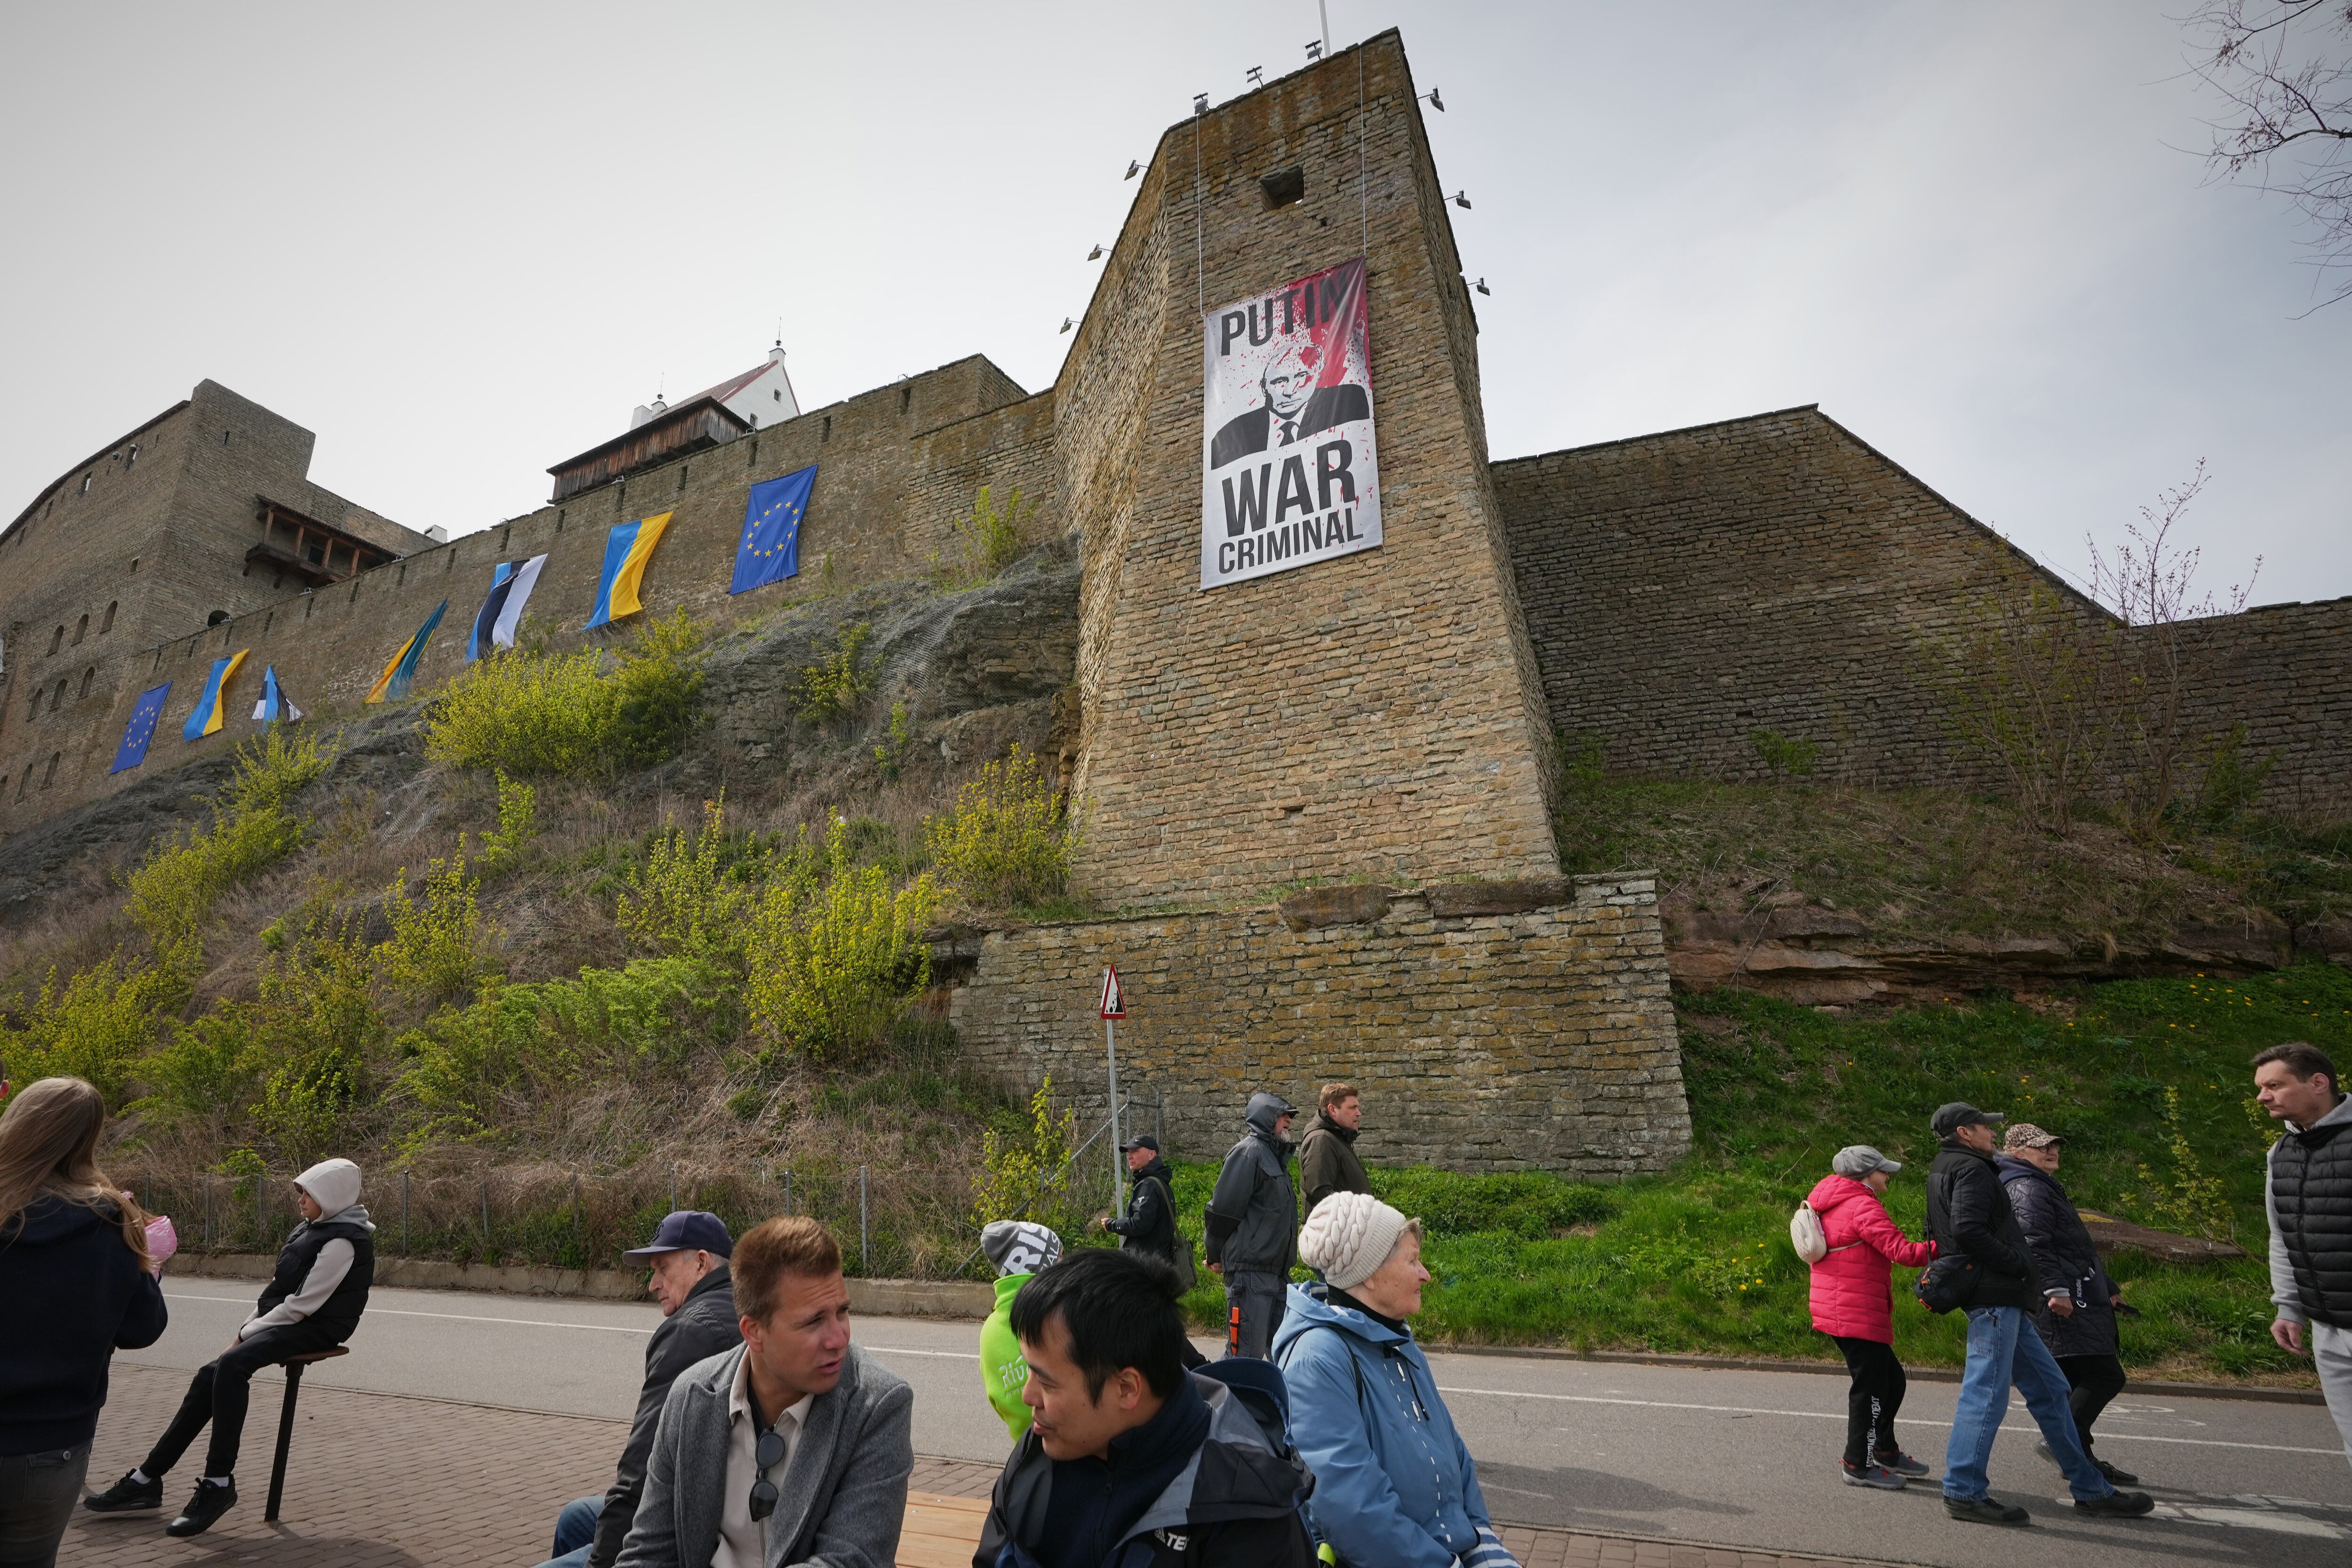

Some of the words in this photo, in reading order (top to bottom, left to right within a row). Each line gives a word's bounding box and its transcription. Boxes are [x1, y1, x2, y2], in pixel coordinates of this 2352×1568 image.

[1221, 269, 1348, 356] PUTIN
[1222, 439, 1356, 537] WAR
[1219, 507, 1363, 574] CRIMINAL
[999, 1221, 1049, 1277] RIS
